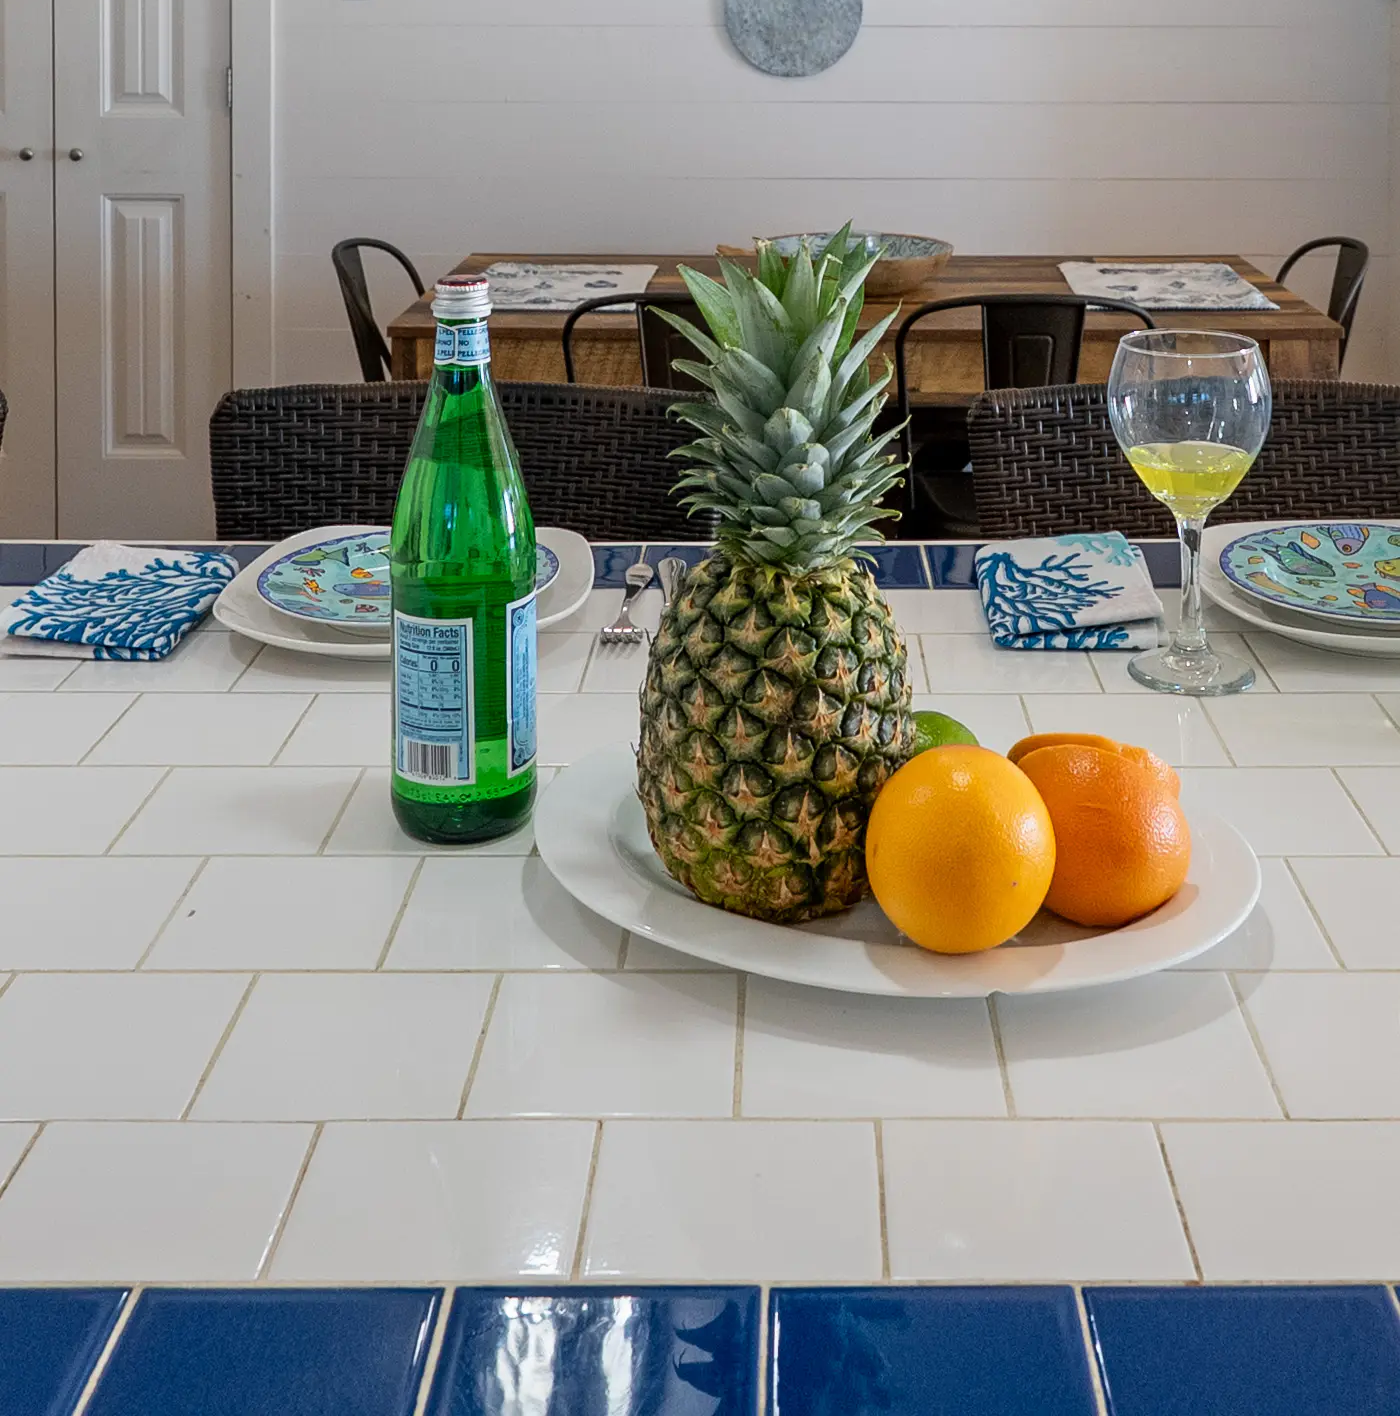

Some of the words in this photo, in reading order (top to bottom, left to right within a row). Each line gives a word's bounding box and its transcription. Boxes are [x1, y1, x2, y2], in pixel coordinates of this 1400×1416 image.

[400, 621, 431, 637] Nutrition
[434, 627, 459, 638] Facts
[430, 660, 438, 671] 0
[452, 660, 459, 671] 0
